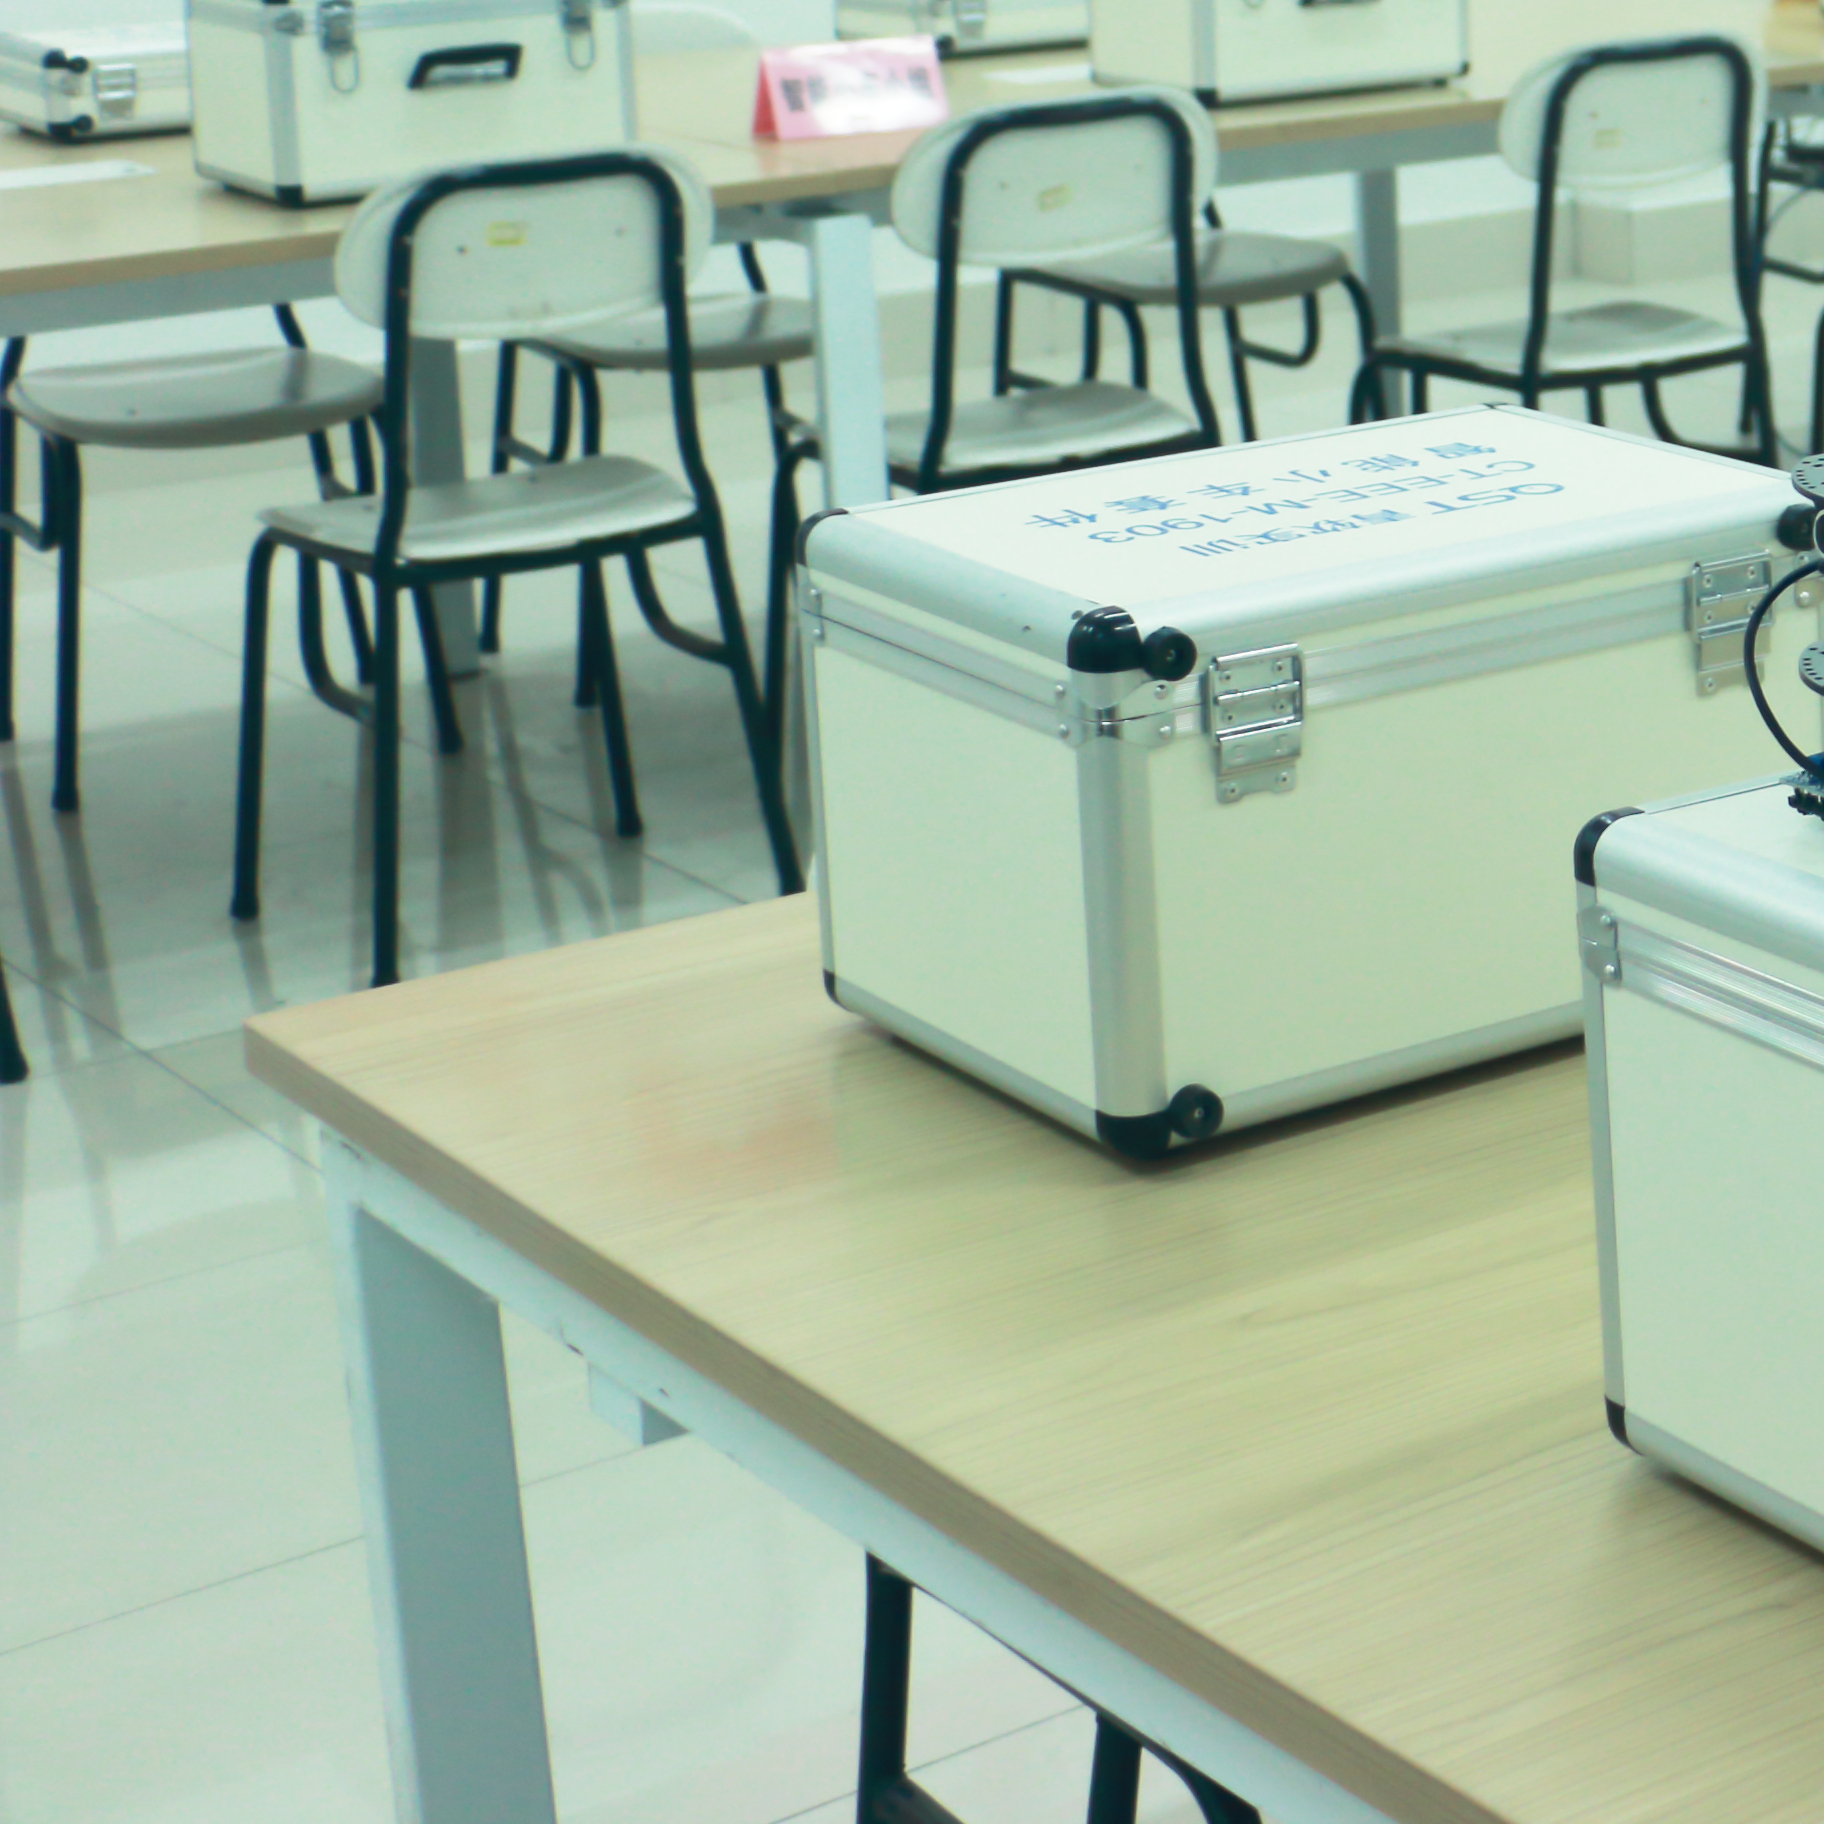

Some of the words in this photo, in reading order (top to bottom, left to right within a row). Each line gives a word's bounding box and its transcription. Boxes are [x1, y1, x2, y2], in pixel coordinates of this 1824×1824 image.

[1024, 441, 1497, 529] 智能小车套件
[1088, 459, 1535, 544] CT-EEE-M-1903
[1423, 482, 1564, 516] QST
